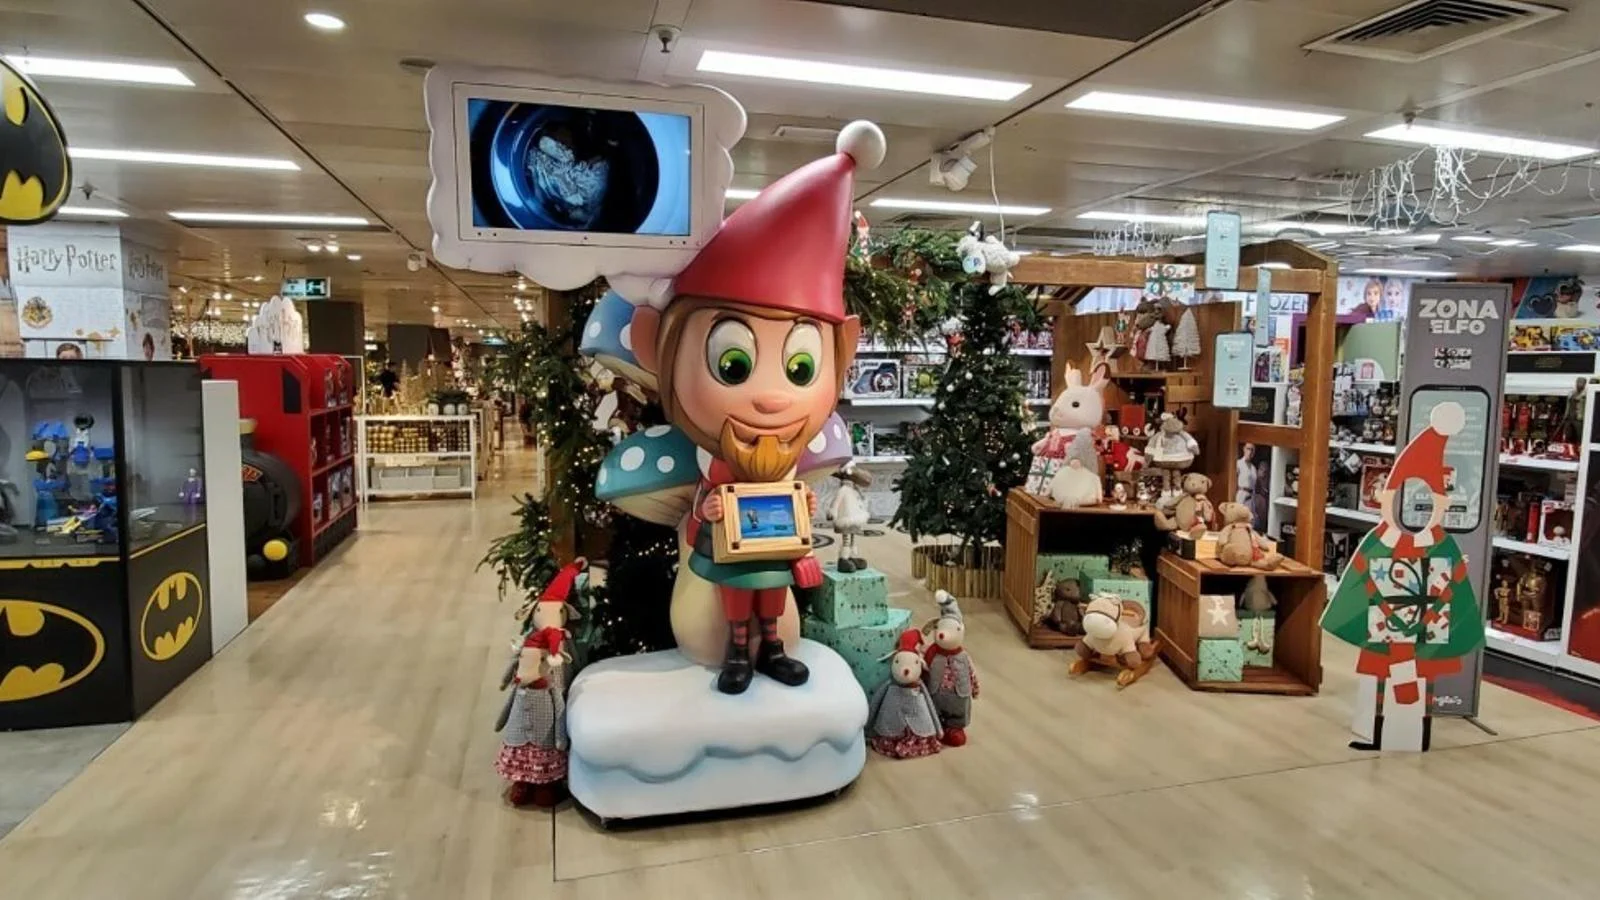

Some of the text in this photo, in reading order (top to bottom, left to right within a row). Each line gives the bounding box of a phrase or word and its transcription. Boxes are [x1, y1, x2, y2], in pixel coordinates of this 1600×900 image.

[16, 244, 117, 276] Harry Potter
[1419, 299, 1499, 319] ZONA
[1430, 320, 1485, 335] ELFO
